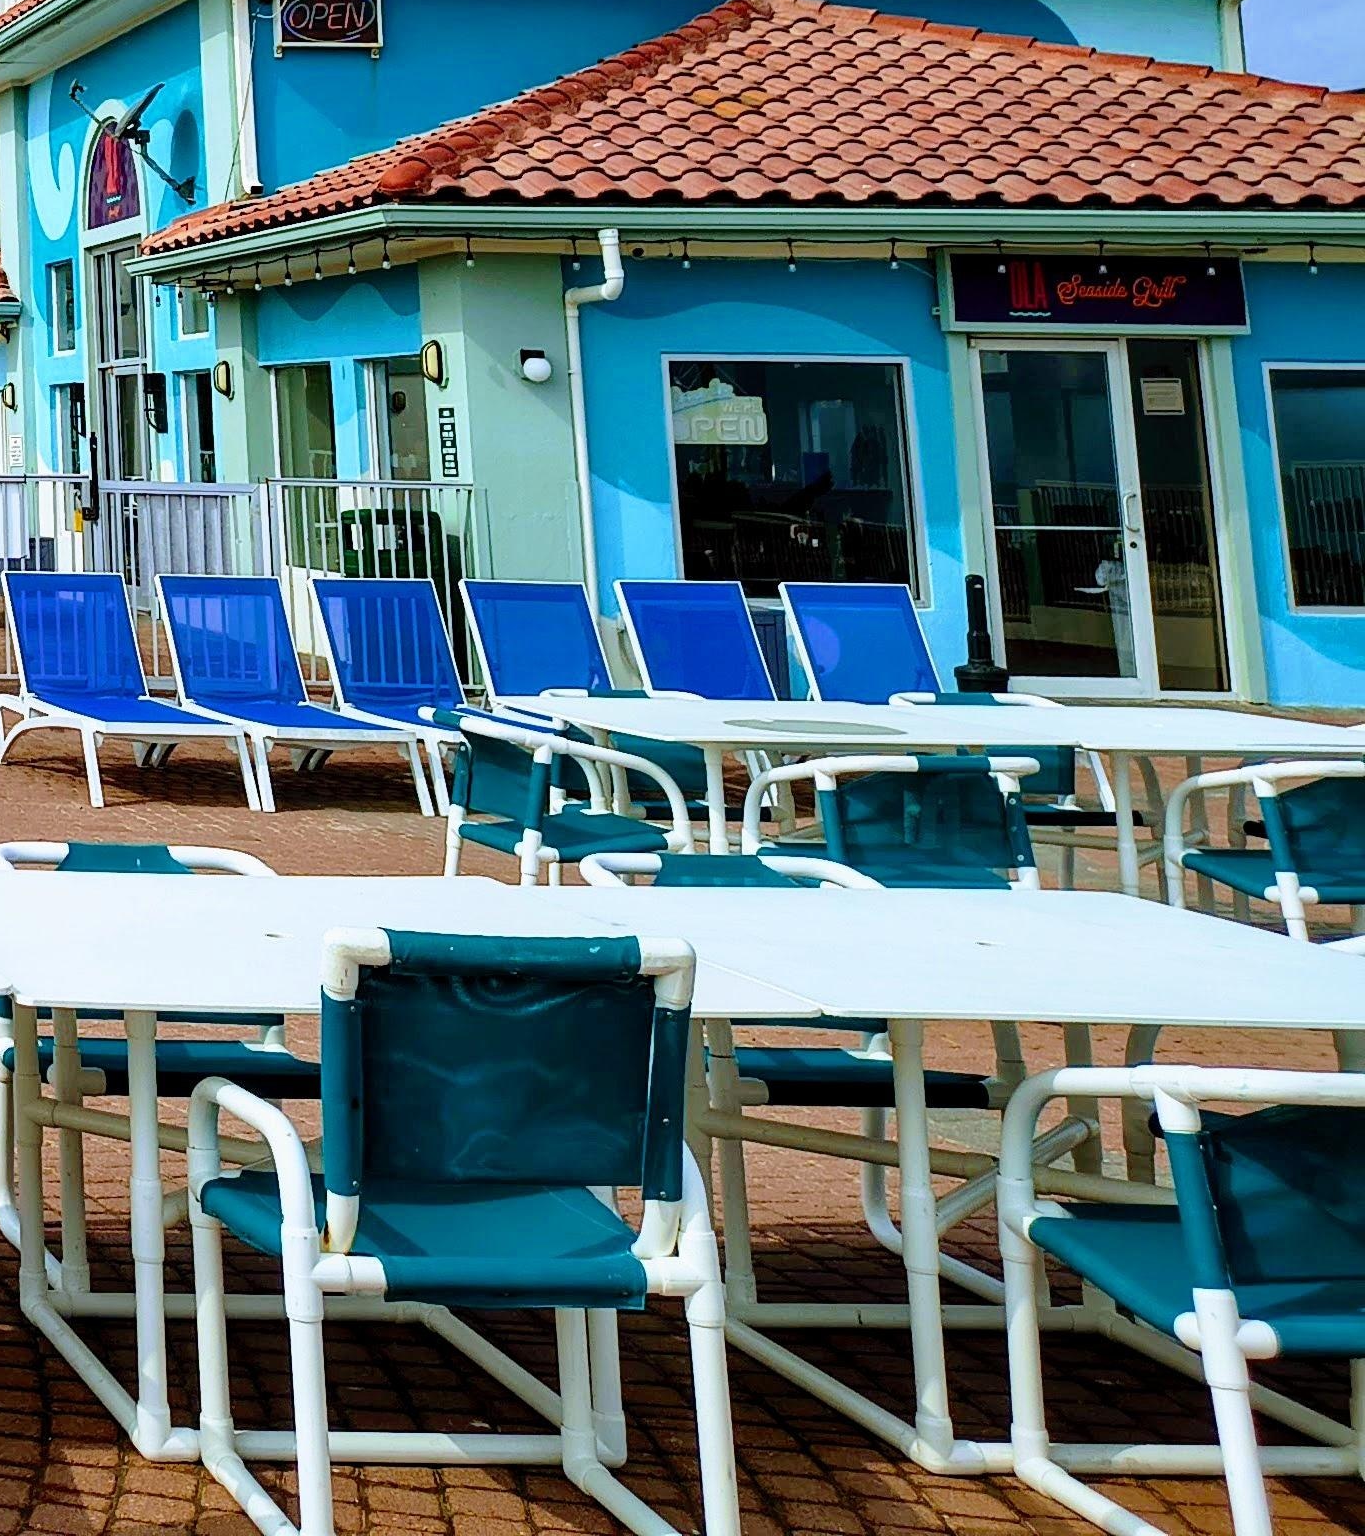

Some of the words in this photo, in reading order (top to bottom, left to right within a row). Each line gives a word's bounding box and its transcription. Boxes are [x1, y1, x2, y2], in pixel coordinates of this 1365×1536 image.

[288, 1, 367, 30] OPEN
[1057, 274, 1128, 305] Seaside
[1132, 276, 1188, 308] Grill
